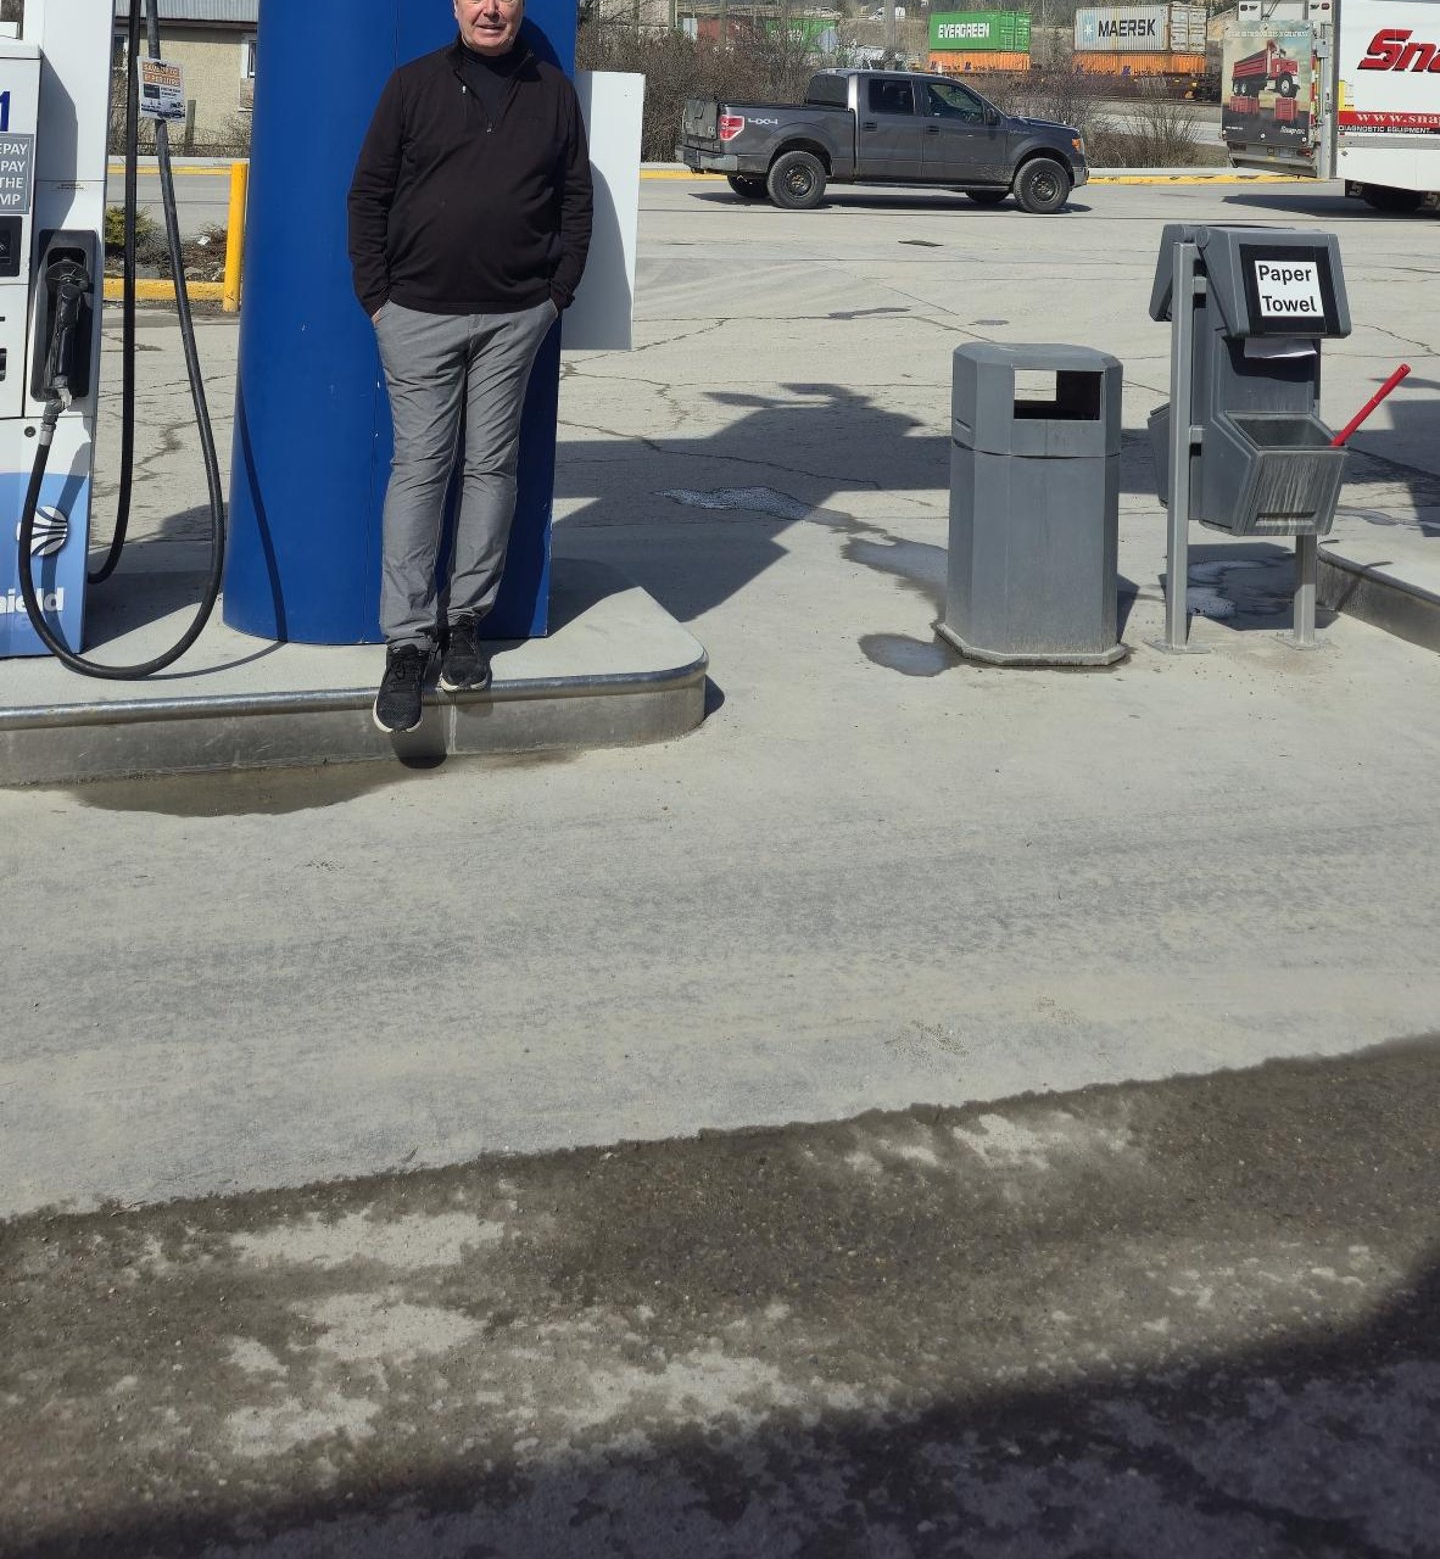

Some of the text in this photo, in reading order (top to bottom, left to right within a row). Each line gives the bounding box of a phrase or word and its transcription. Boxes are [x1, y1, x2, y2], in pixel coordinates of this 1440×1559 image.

[938, 23, 990, 38] EVERGREEN
[1098, 19, 1156, 37] MAERSK
[1357, 113, 1440, 126] www.sna
[1339, 125, 1384, 133] DIAGNOSTIC
[1, 160, 26, 172] PAY
[1258, 265, 1311, 285] Paper
[1262, 295, 1317, 312] Towel
